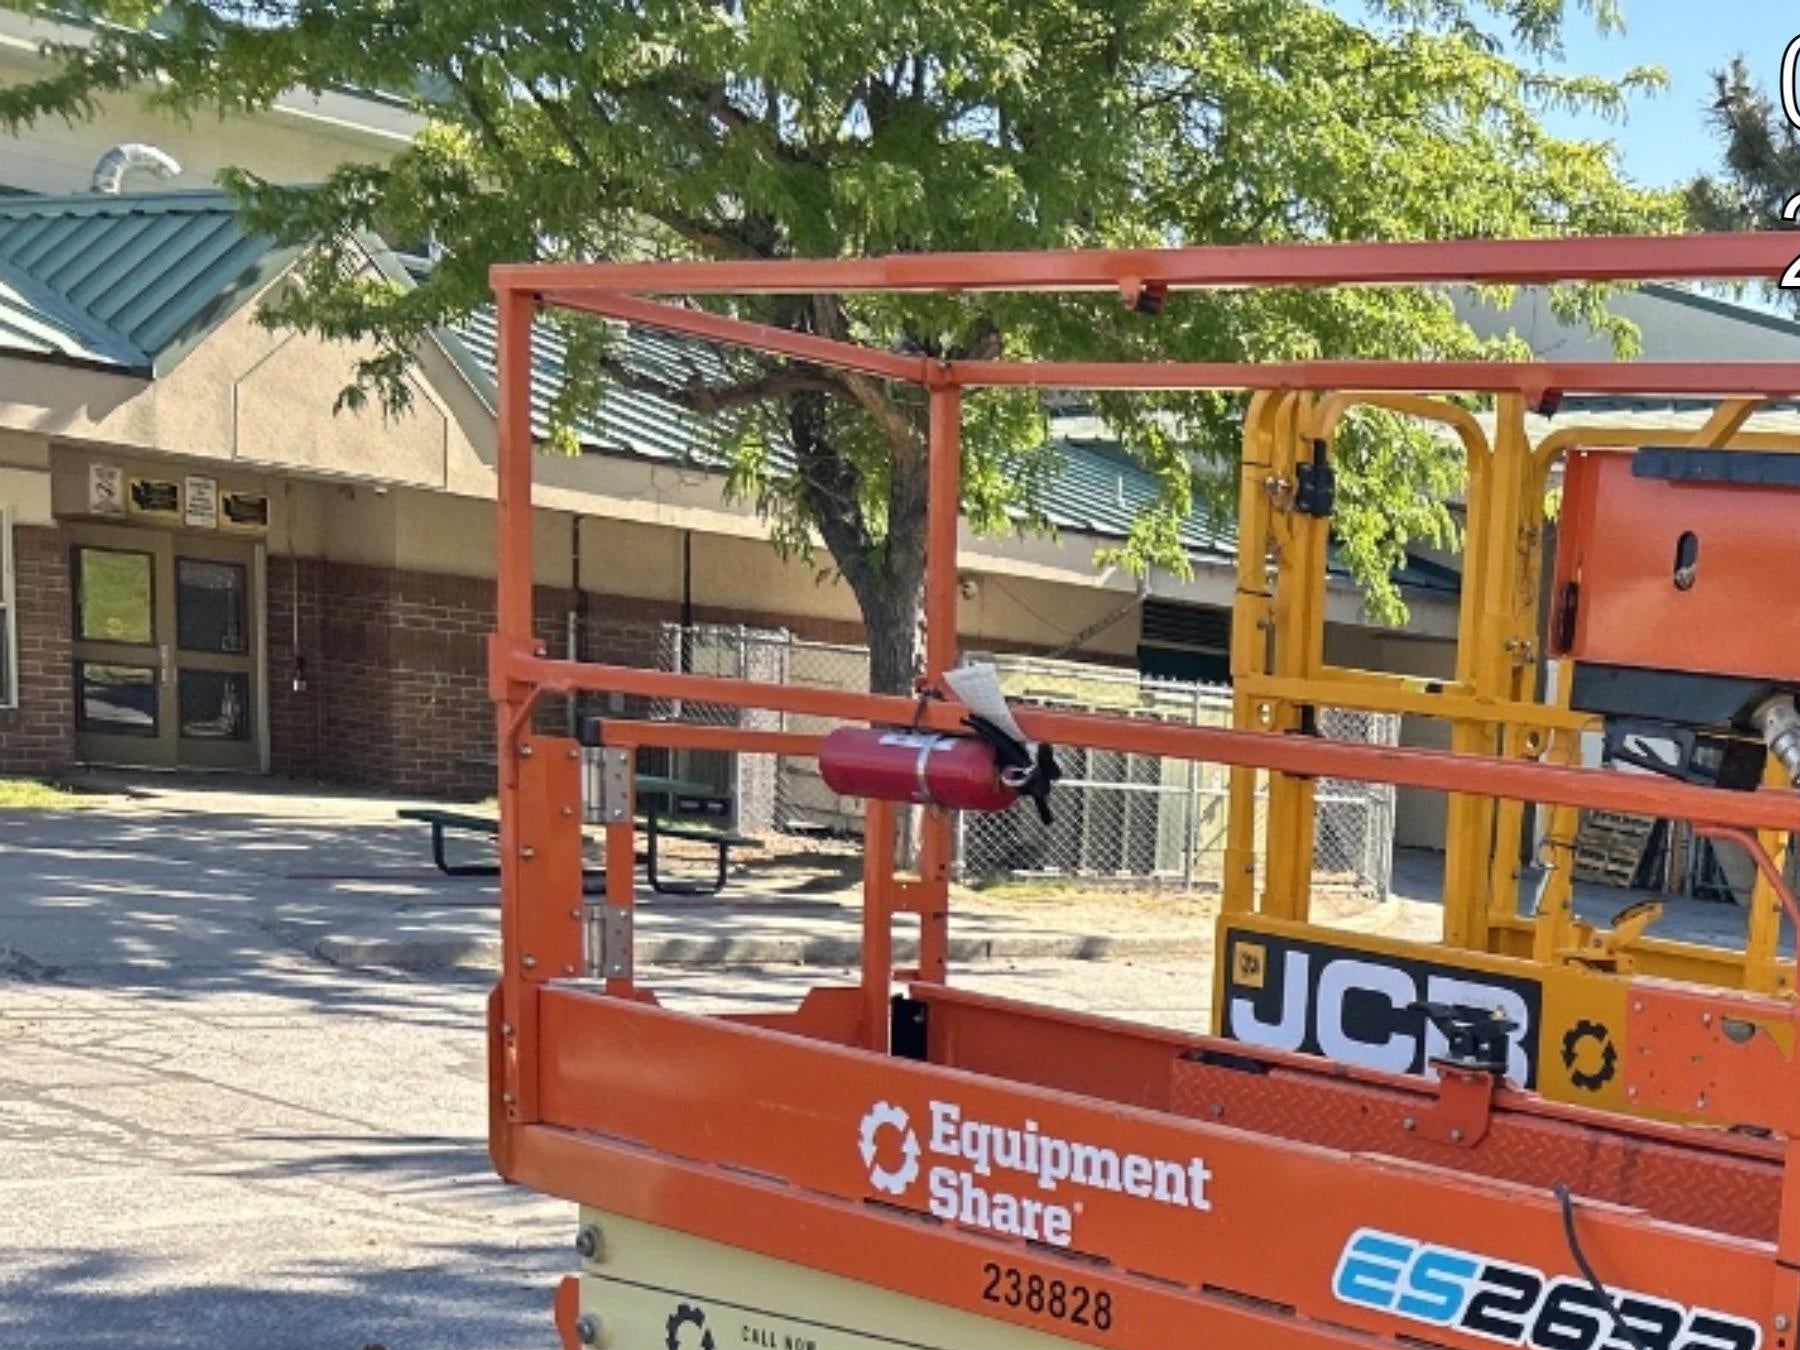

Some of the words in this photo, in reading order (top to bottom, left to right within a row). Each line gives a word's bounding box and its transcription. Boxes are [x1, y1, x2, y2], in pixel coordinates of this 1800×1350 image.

[928, 1099, 1213, 1212] Equipment
[981, 1262, 1114, 1331] 238828
[741, 1323, 778, 1349] CALL
